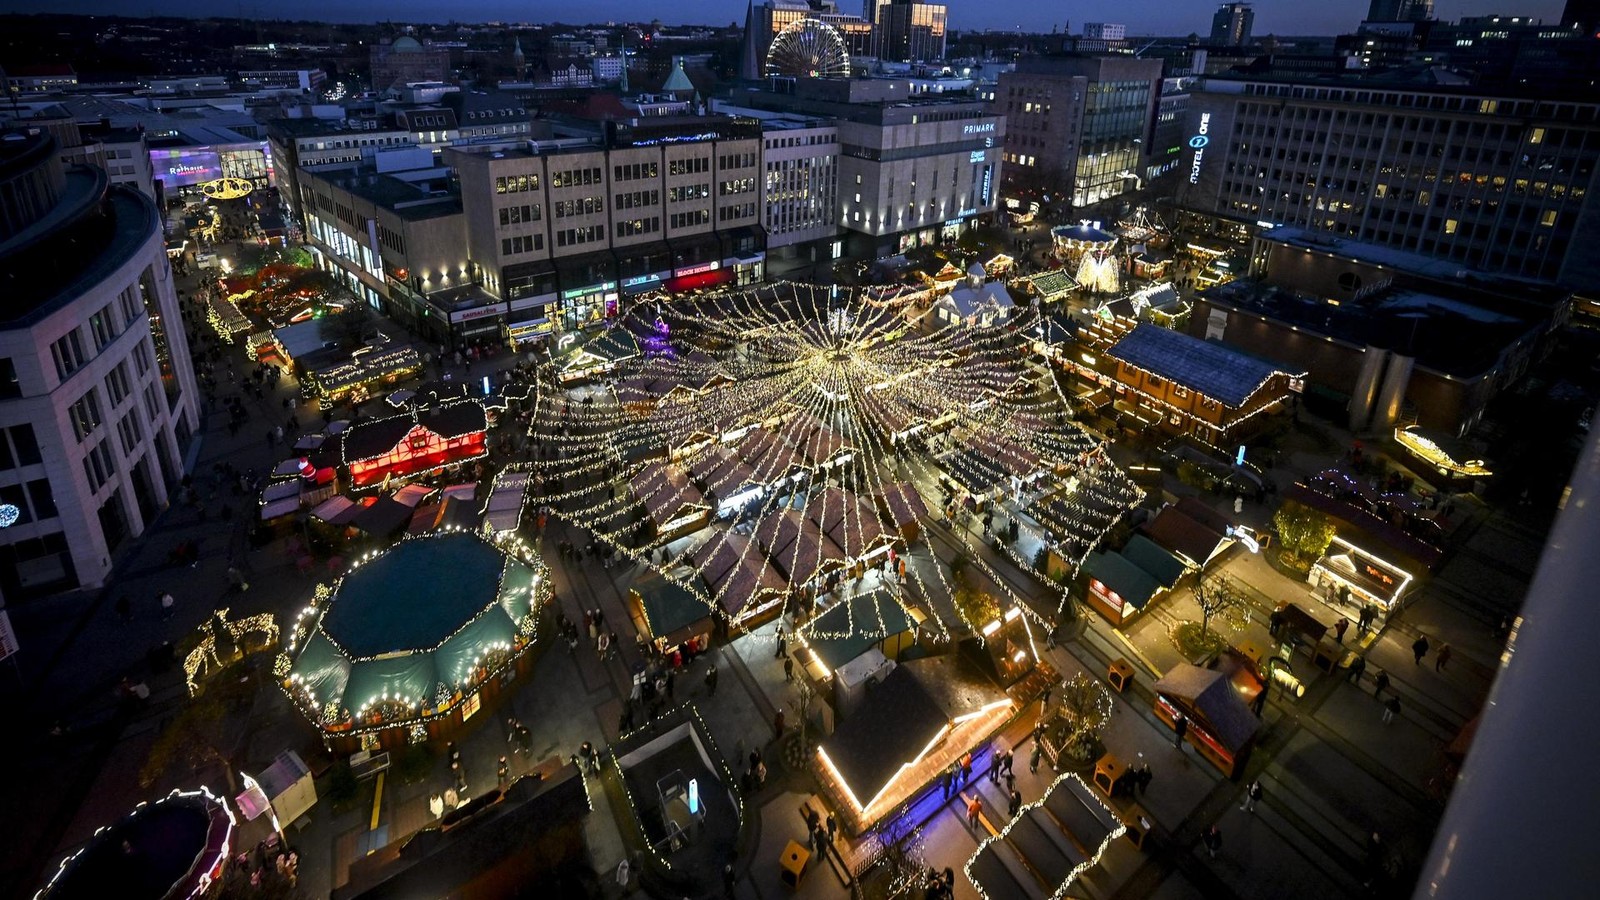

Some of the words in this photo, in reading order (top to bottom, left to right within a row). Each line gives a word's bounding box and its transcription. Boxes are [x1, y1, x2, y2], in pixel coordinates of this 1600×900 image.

[964, 123, 995, 134] PRIMARK
[1199, 112, 1210, 135] ONE
[169, 164, 204, 175] Rathaus
[945, 217, 964, 226] PRIMARK
[677, 267, 694, 277] BLOCK
[694, 264, 710, 274] HOUSE
